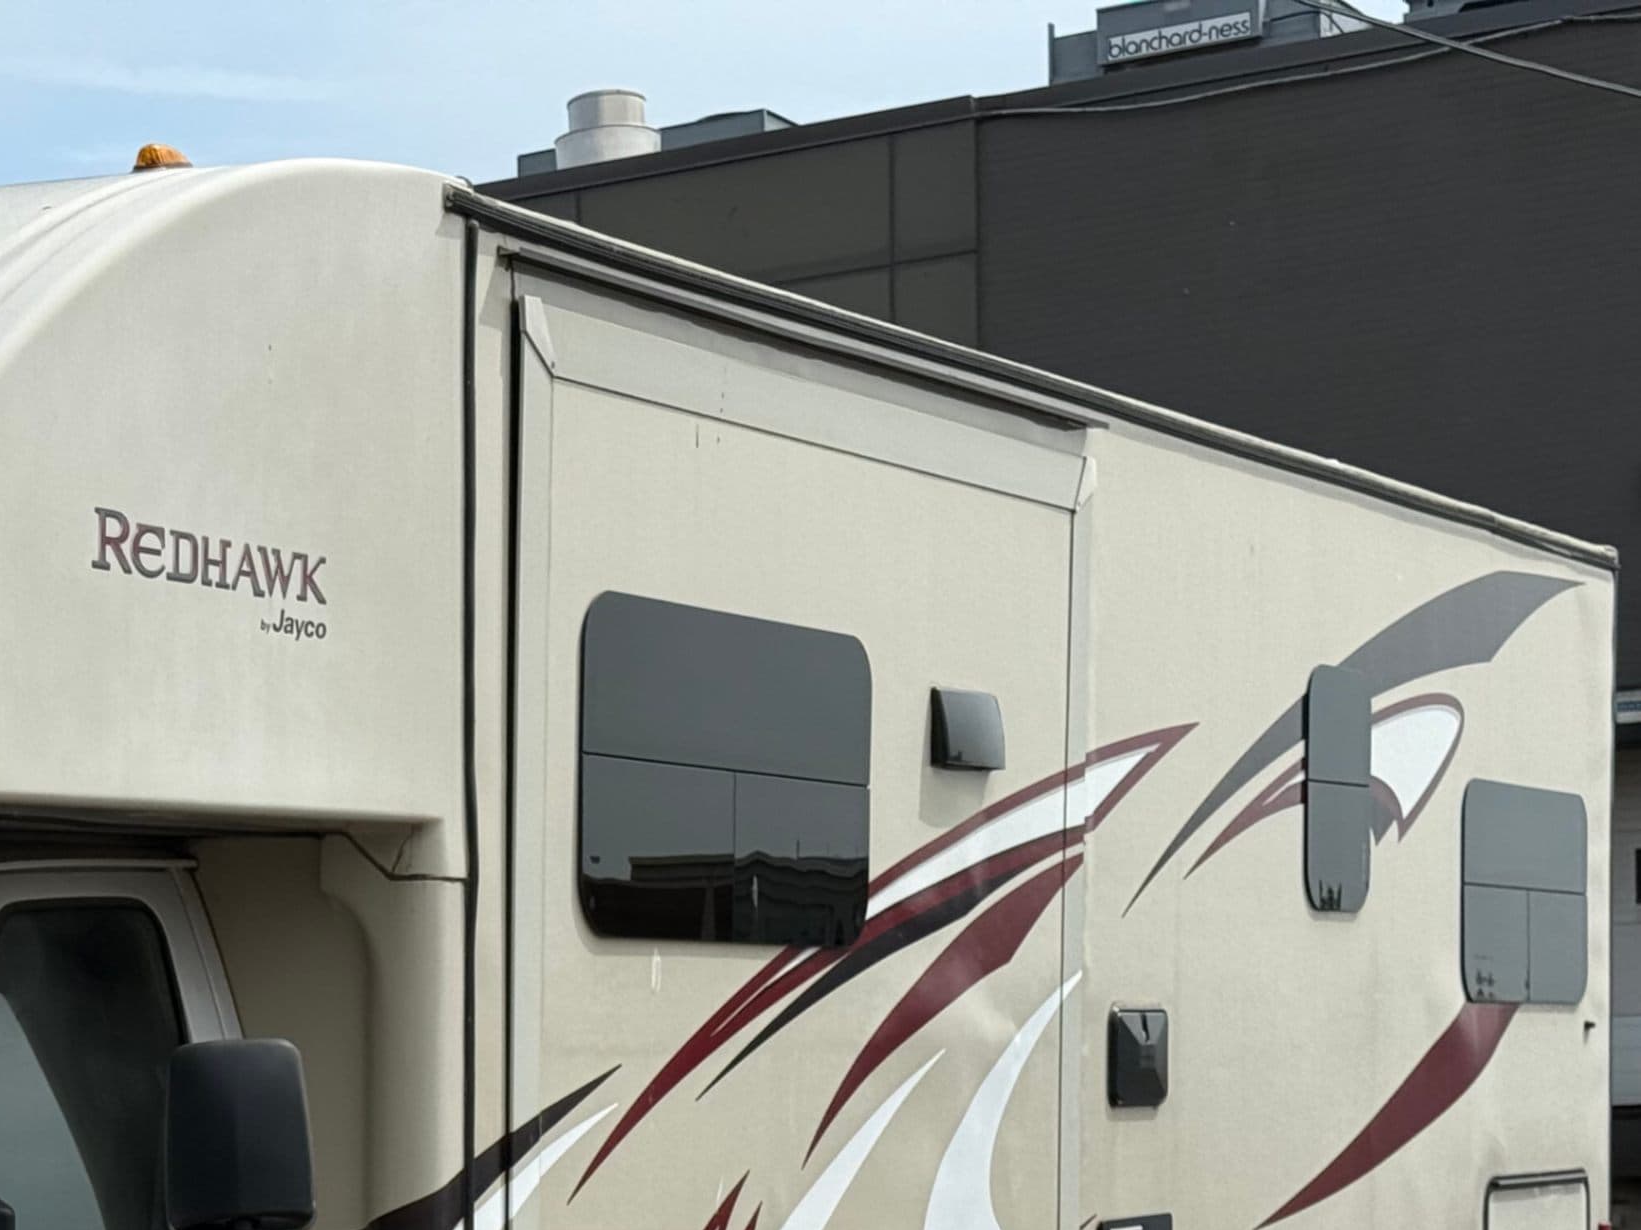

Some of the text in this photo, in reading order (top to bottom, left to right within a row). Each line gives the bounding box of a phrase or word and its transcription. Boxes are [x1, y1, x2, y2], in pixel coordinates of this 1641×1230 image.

[1108, 19, 1251, 59] blanchard-ness
[260, 608, 327, 641] by Jayco
